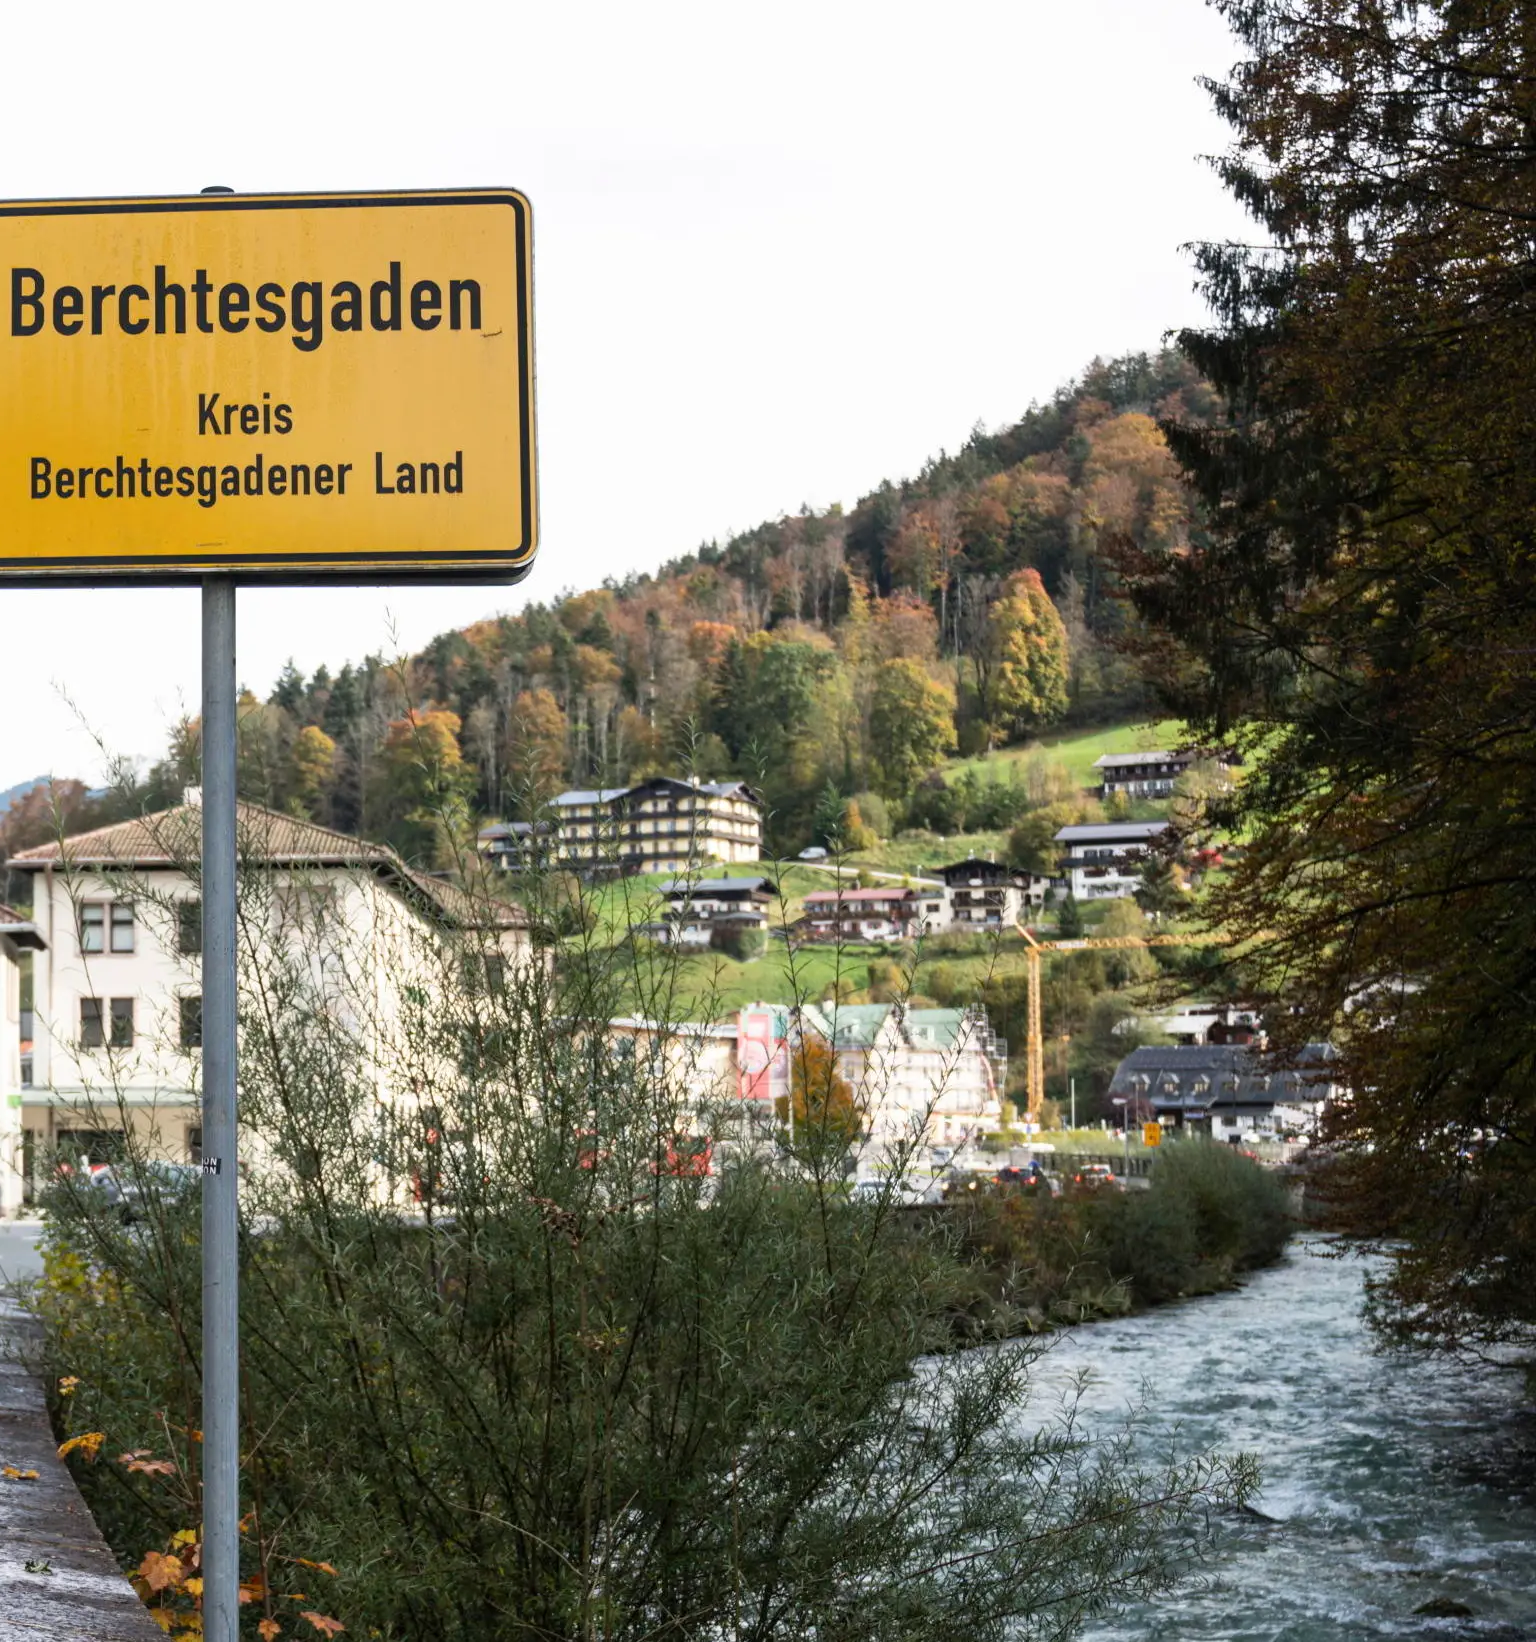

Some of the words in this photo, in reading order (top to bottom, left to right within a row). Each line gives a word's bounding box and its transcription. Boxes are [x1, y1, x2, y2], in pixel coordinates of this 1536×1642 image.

[11, 261, 482, 352] Berchtesgaden
[198, 393, 293, 436] Kreis
[30, 453, 353, 509] Berchtesgadener
[375, 450, 464, 494] Land
